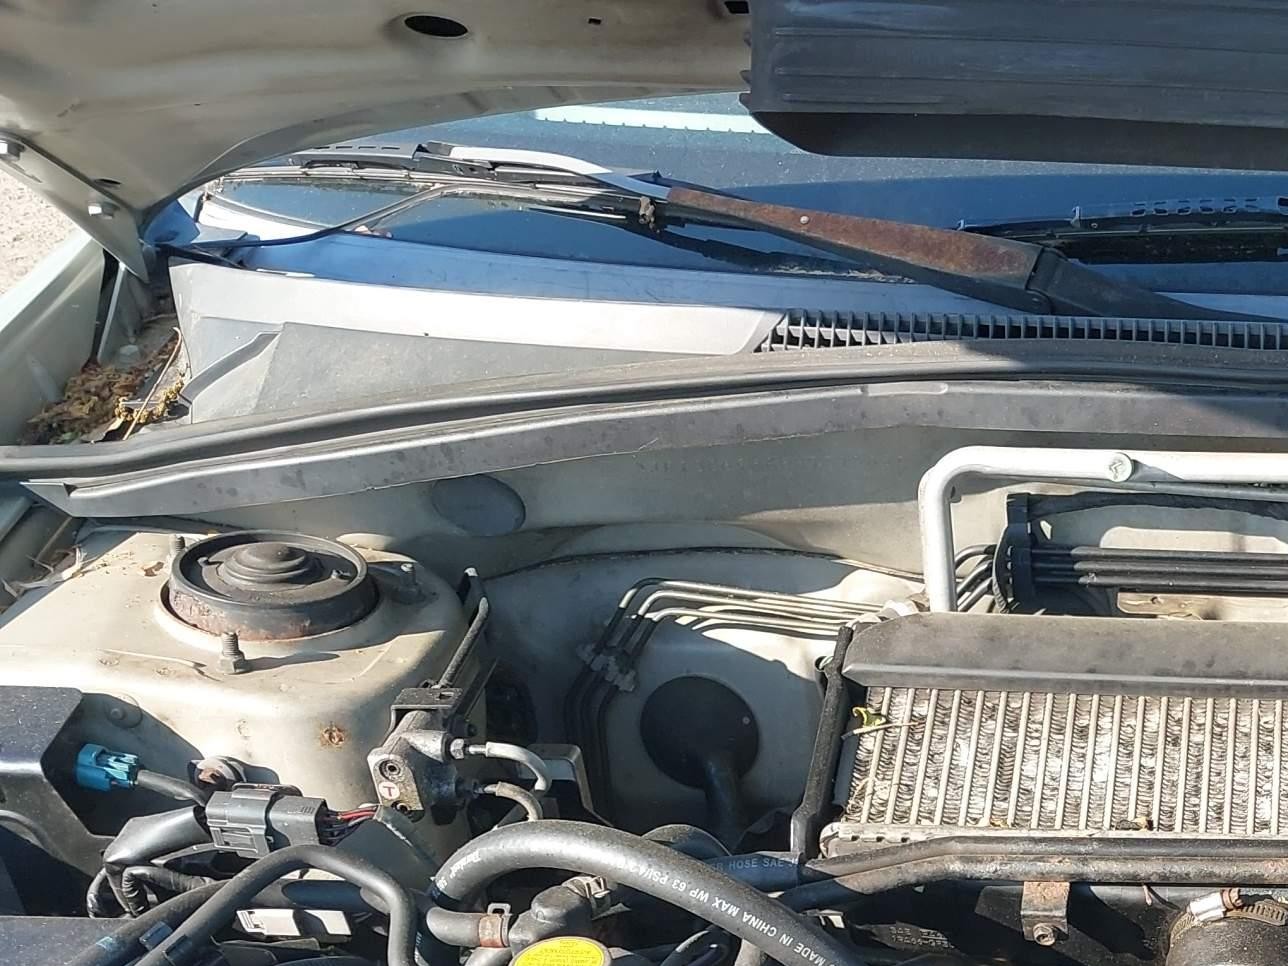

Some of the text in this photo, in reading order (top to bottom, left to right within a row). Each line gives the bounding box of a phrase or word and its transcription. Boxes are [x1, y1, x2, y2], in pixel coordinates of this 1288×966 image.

[729, 858, 758, 870] HOSE
[763, 858, 784, 868] SAE
[671, 880, 687, 891] 63
[689, 888, 709, 903] WP
[712, 896, 738, 917] MAX
[743, 912, 778, 937] CHINA
[779, 933, 794, 946] IN
[794, 942, 825, 966] MADE
